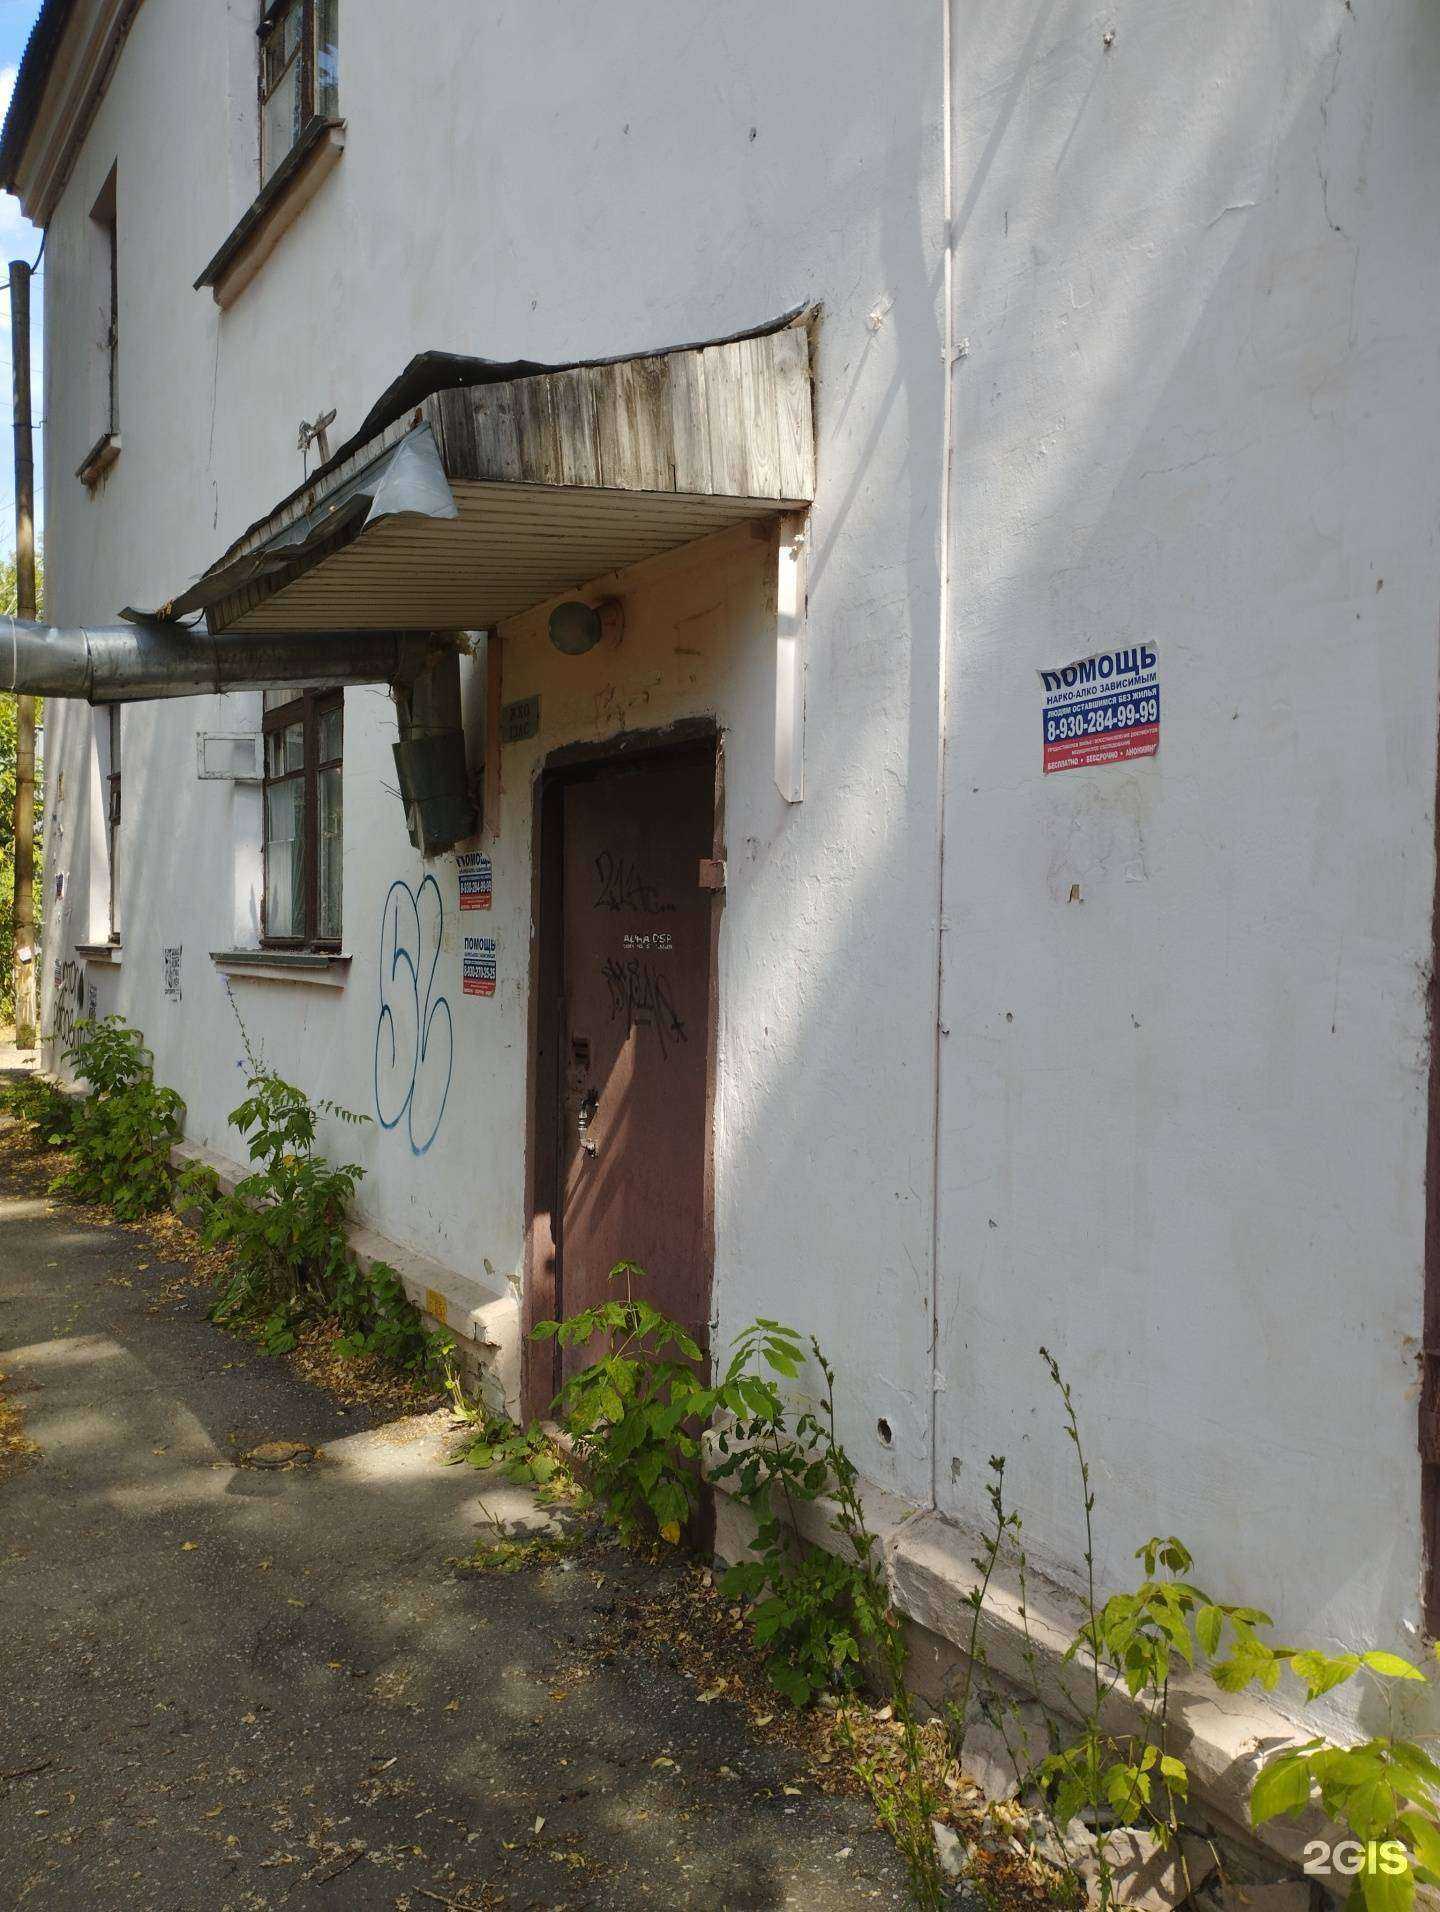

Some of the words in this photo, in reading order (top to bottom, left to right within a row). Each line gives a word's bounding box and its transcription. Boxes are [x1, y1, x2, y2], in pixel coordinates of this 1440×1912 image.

[1041, 646, 1157, 692] ПОМОЩЬ
[1047, 686, 1097, 705] НАРКО-АЛКО
[1100, 673, 1157, 692] ЗАВИСИМЫМ
[1073, 697, 1117, 713] ОСТАВШИМСЯ
[1119, 694, 1131, 703] БЕЗ
[1132, 688, 1157, 700] ЖИЛЬЯ
[1047, 699, 1158, 741] 8-930-284-99-99
[464, 937, 495, 953] ПОМОЩЬ
